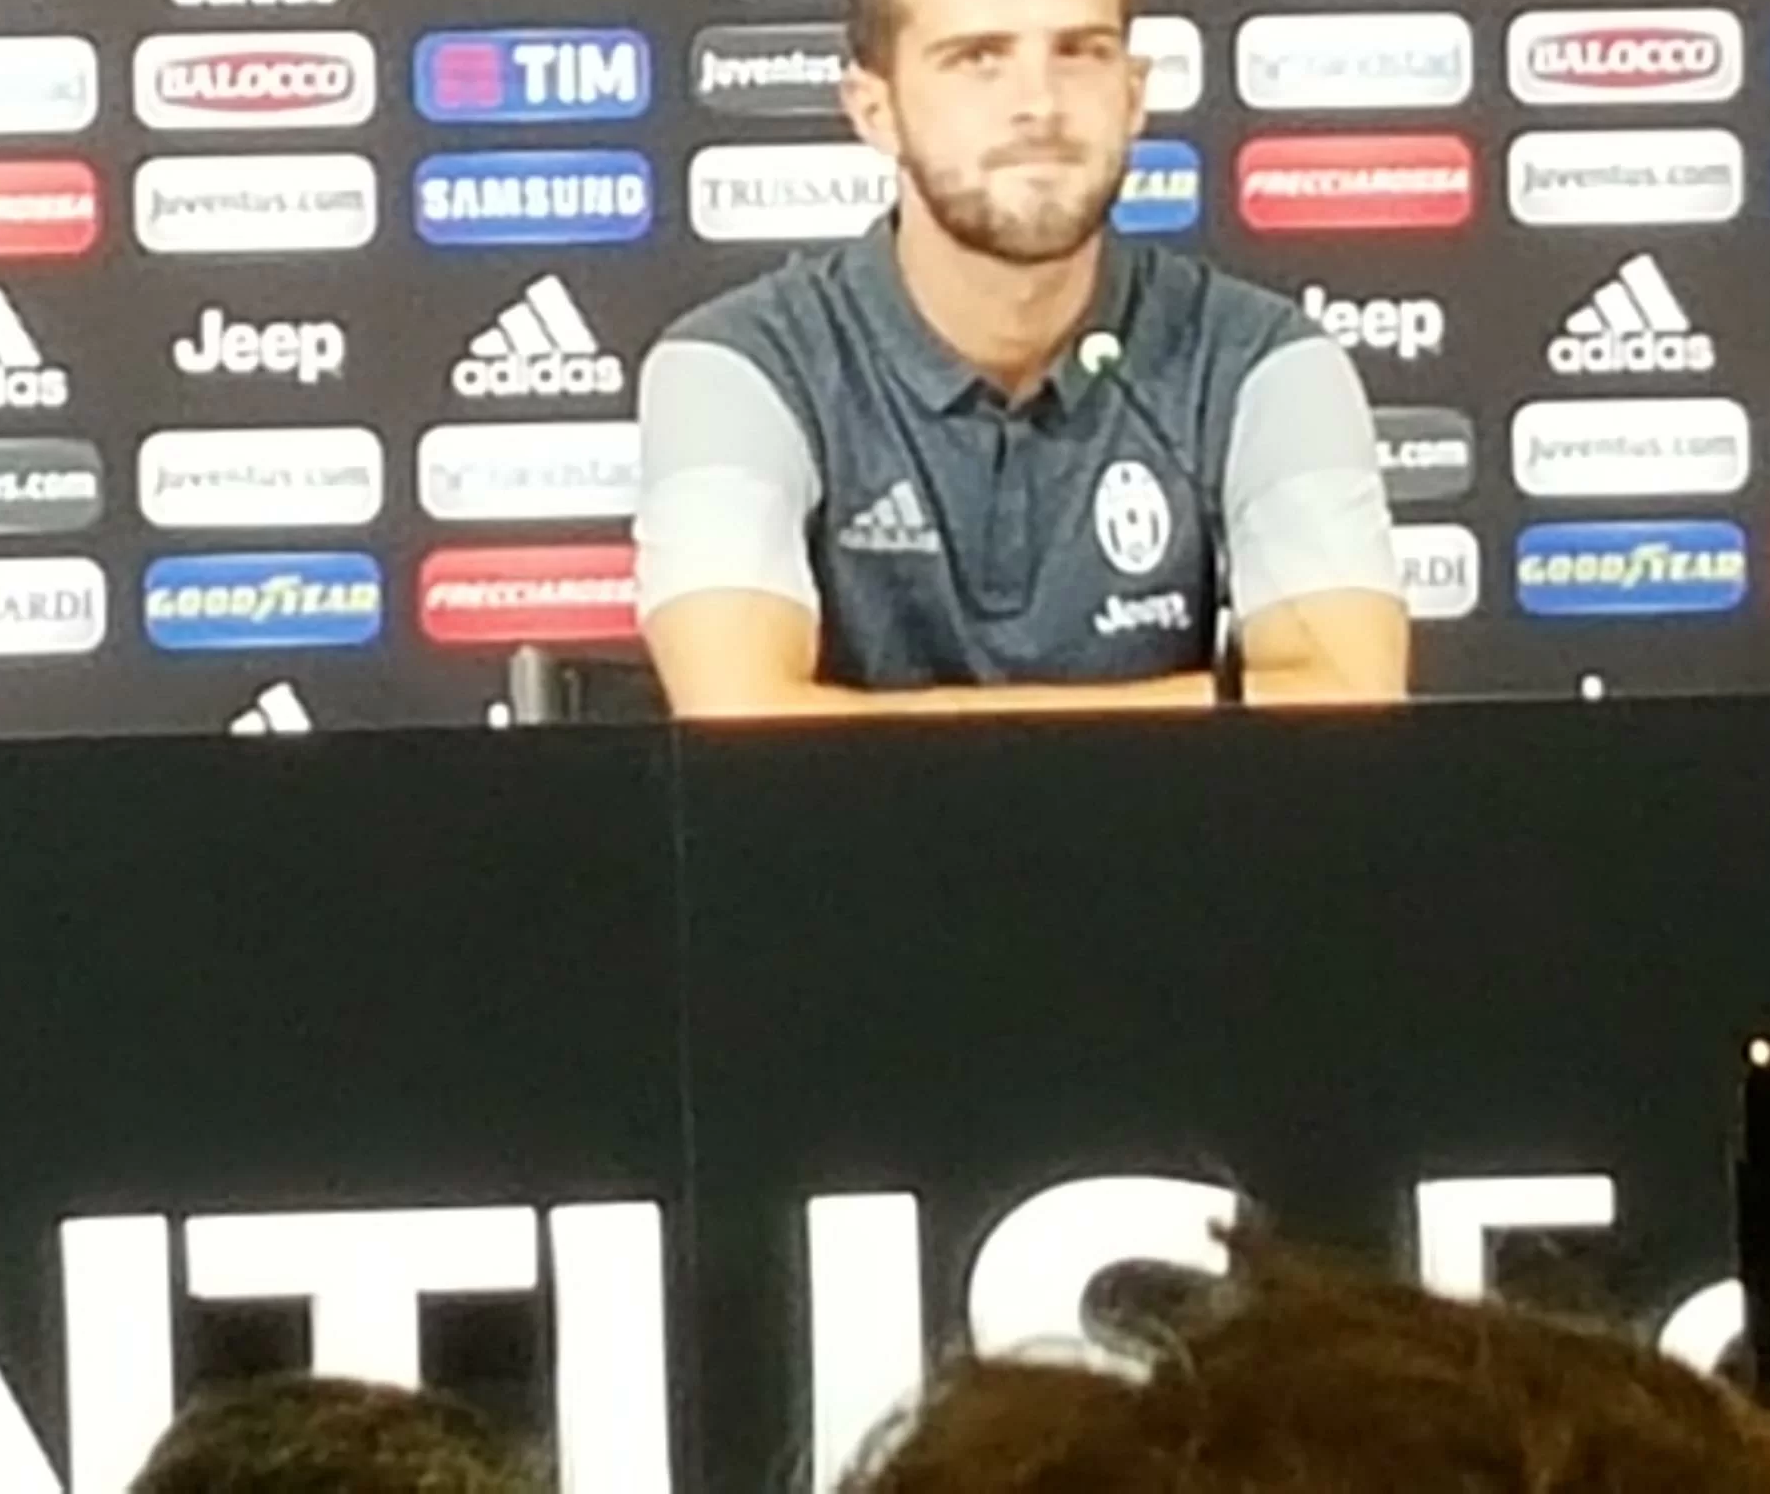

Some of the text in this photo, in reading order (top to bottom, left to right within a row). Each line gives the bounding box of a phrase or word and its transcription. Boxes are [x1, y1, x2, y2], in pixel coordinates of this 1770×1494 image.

[515, 44, 638, 101] TIM
[700, 52, 844, 92] Juventus
[1531, 40, 1717, 73] BALOCCO
[159, 65, 349, 100] BALOCCO
[422, 177, 644, 220] SAMSUNG
[174, 309, 347, 381] Jeep
[1548, 330, 1716, 373] adidas
[452, 356, 624, 396] adidas
[152, 461, 370, 495] Juventuscom
[1519, 542, 1745, 588] GOODYEAR
[147, 574, 379, 621] GOODYEAR
[428, 576, 639, 609] FRECCIAROSS
